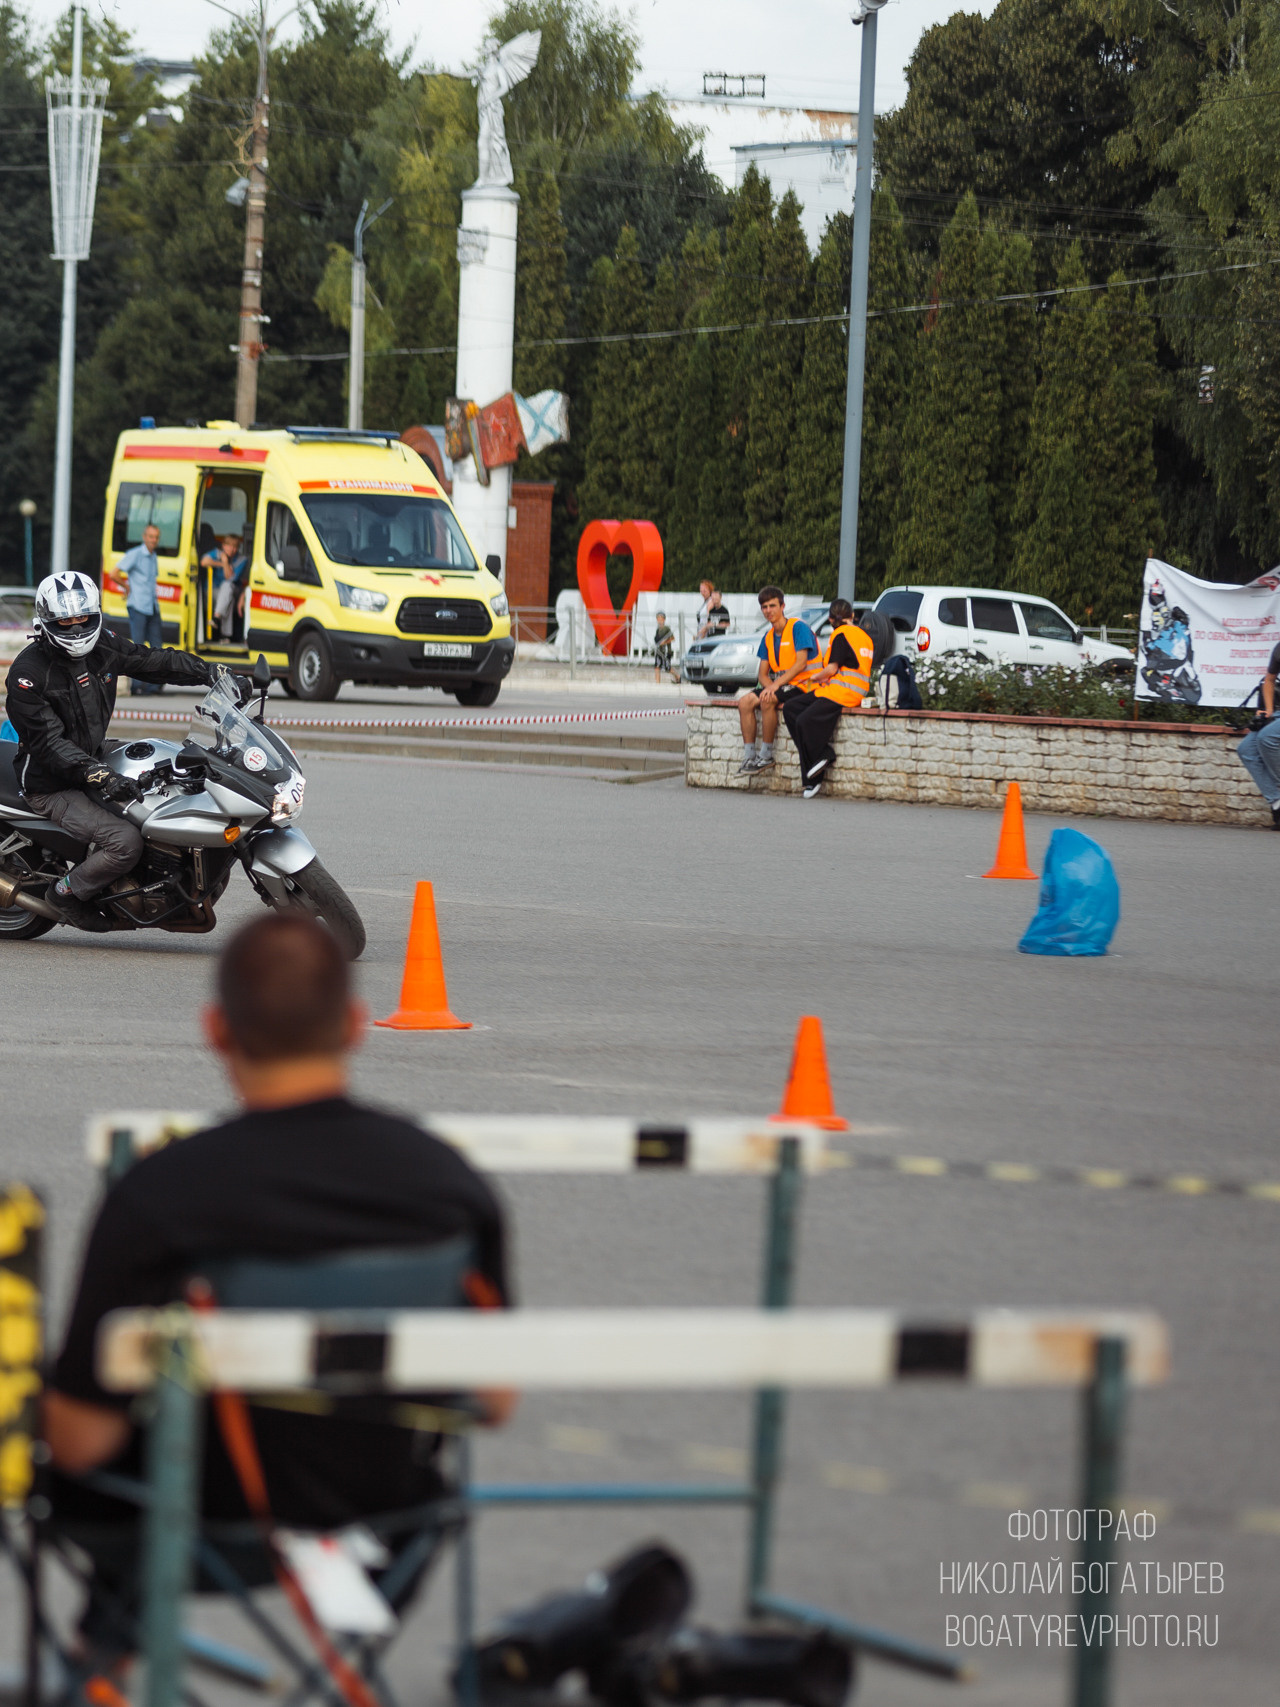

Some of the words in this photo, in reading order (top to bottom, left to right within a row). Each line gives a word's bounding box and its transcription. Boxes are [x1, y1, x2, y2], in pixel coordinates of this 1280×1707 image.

[328, 480, 414, 493] РЕАНИМАЦИЯ
[261, 594, 296, 613] ПОМОЩЬ
[249, 752, 263, 765] 15
